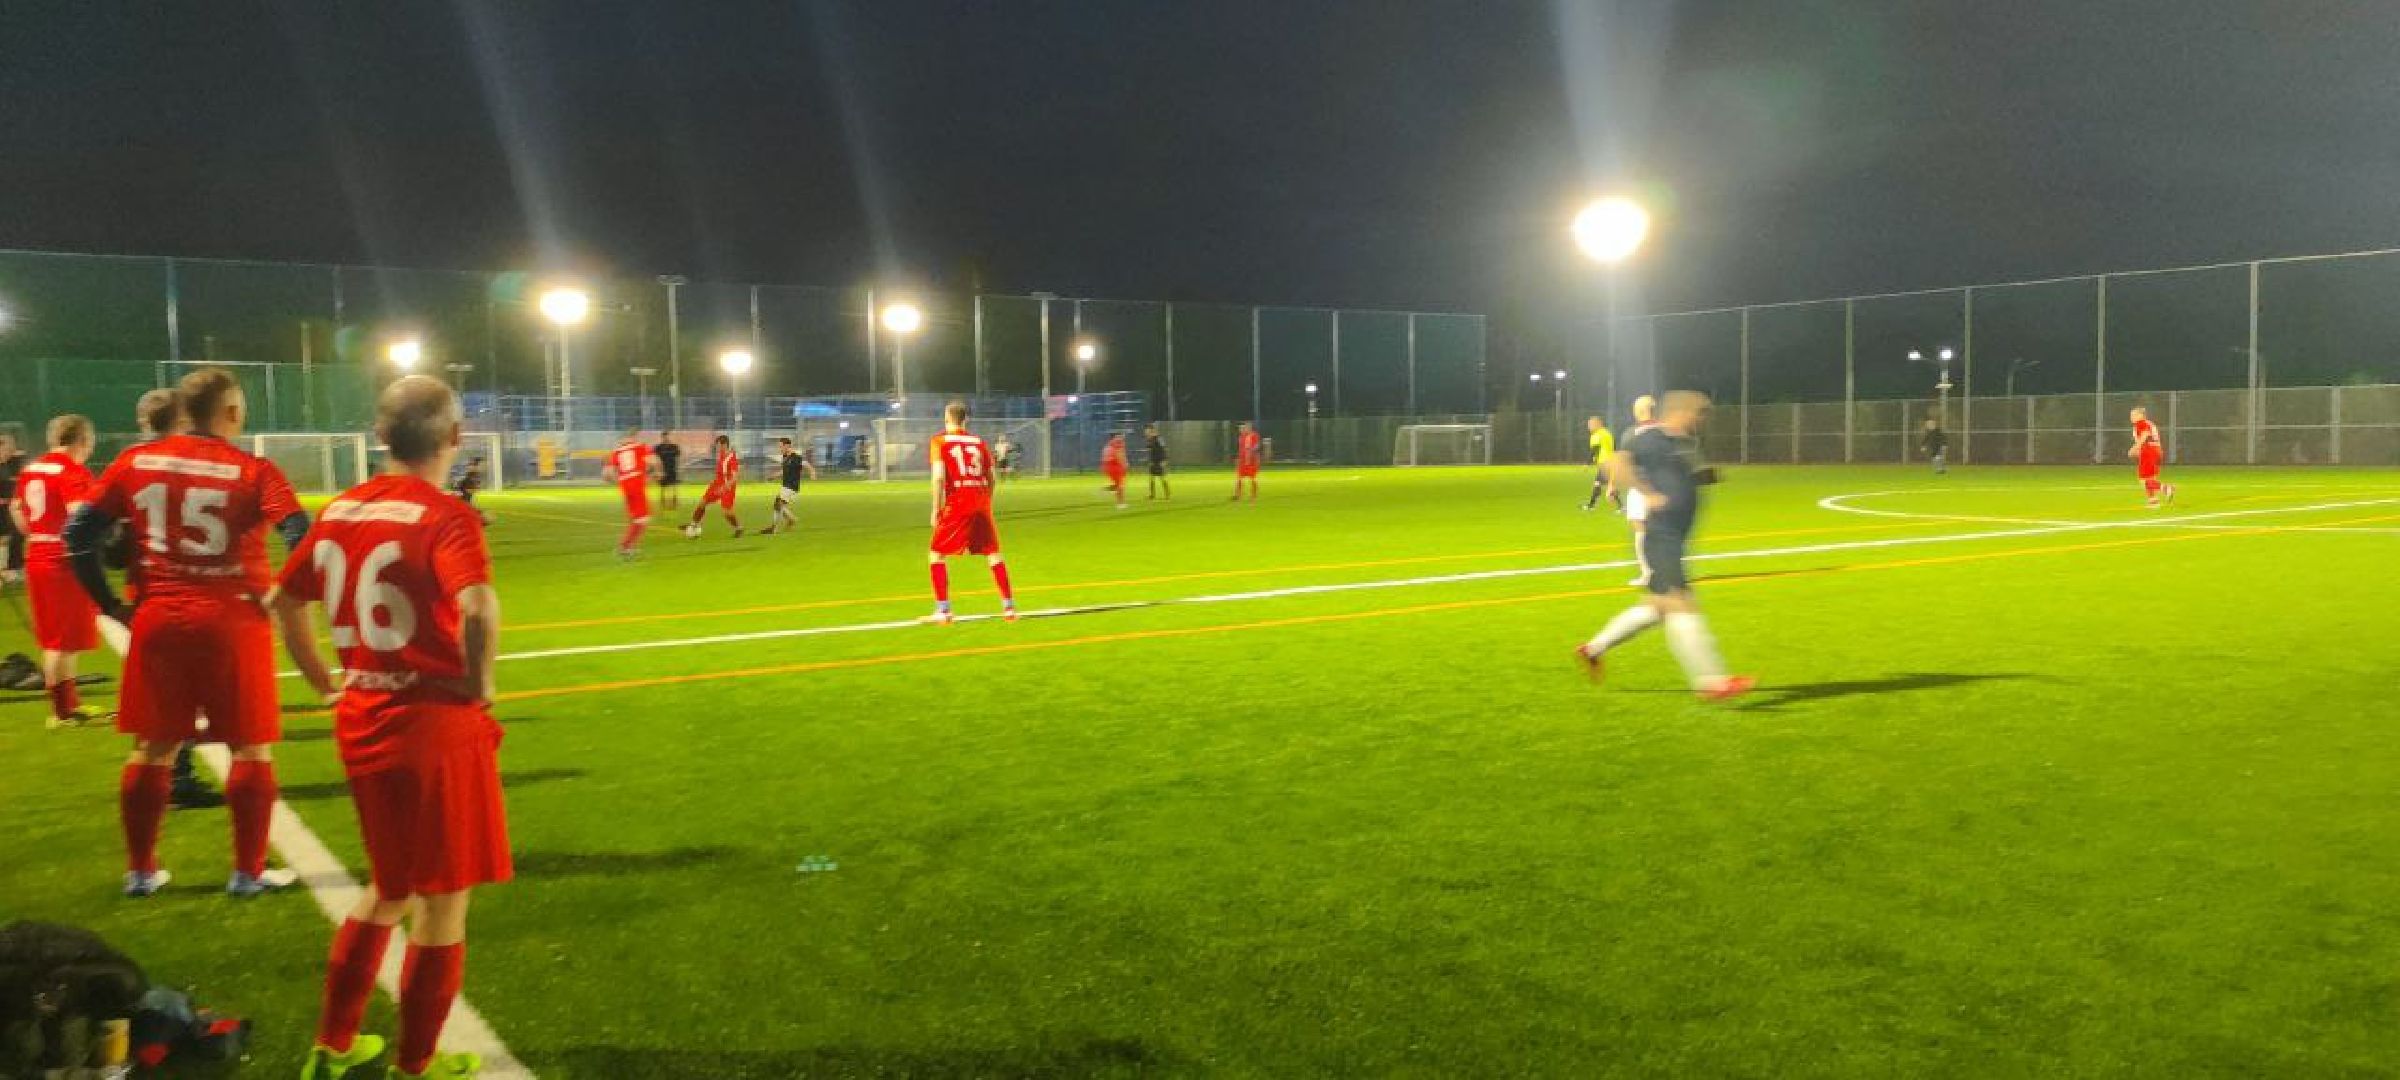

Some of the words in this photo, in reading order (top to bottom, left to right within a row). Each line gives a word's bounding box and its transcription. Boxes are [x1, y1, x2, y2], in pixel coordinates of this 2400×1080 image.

[948, 445, 982, 477] 13
[132, 483, 229, 556] 15
[312, 539, 417, 651] 26
